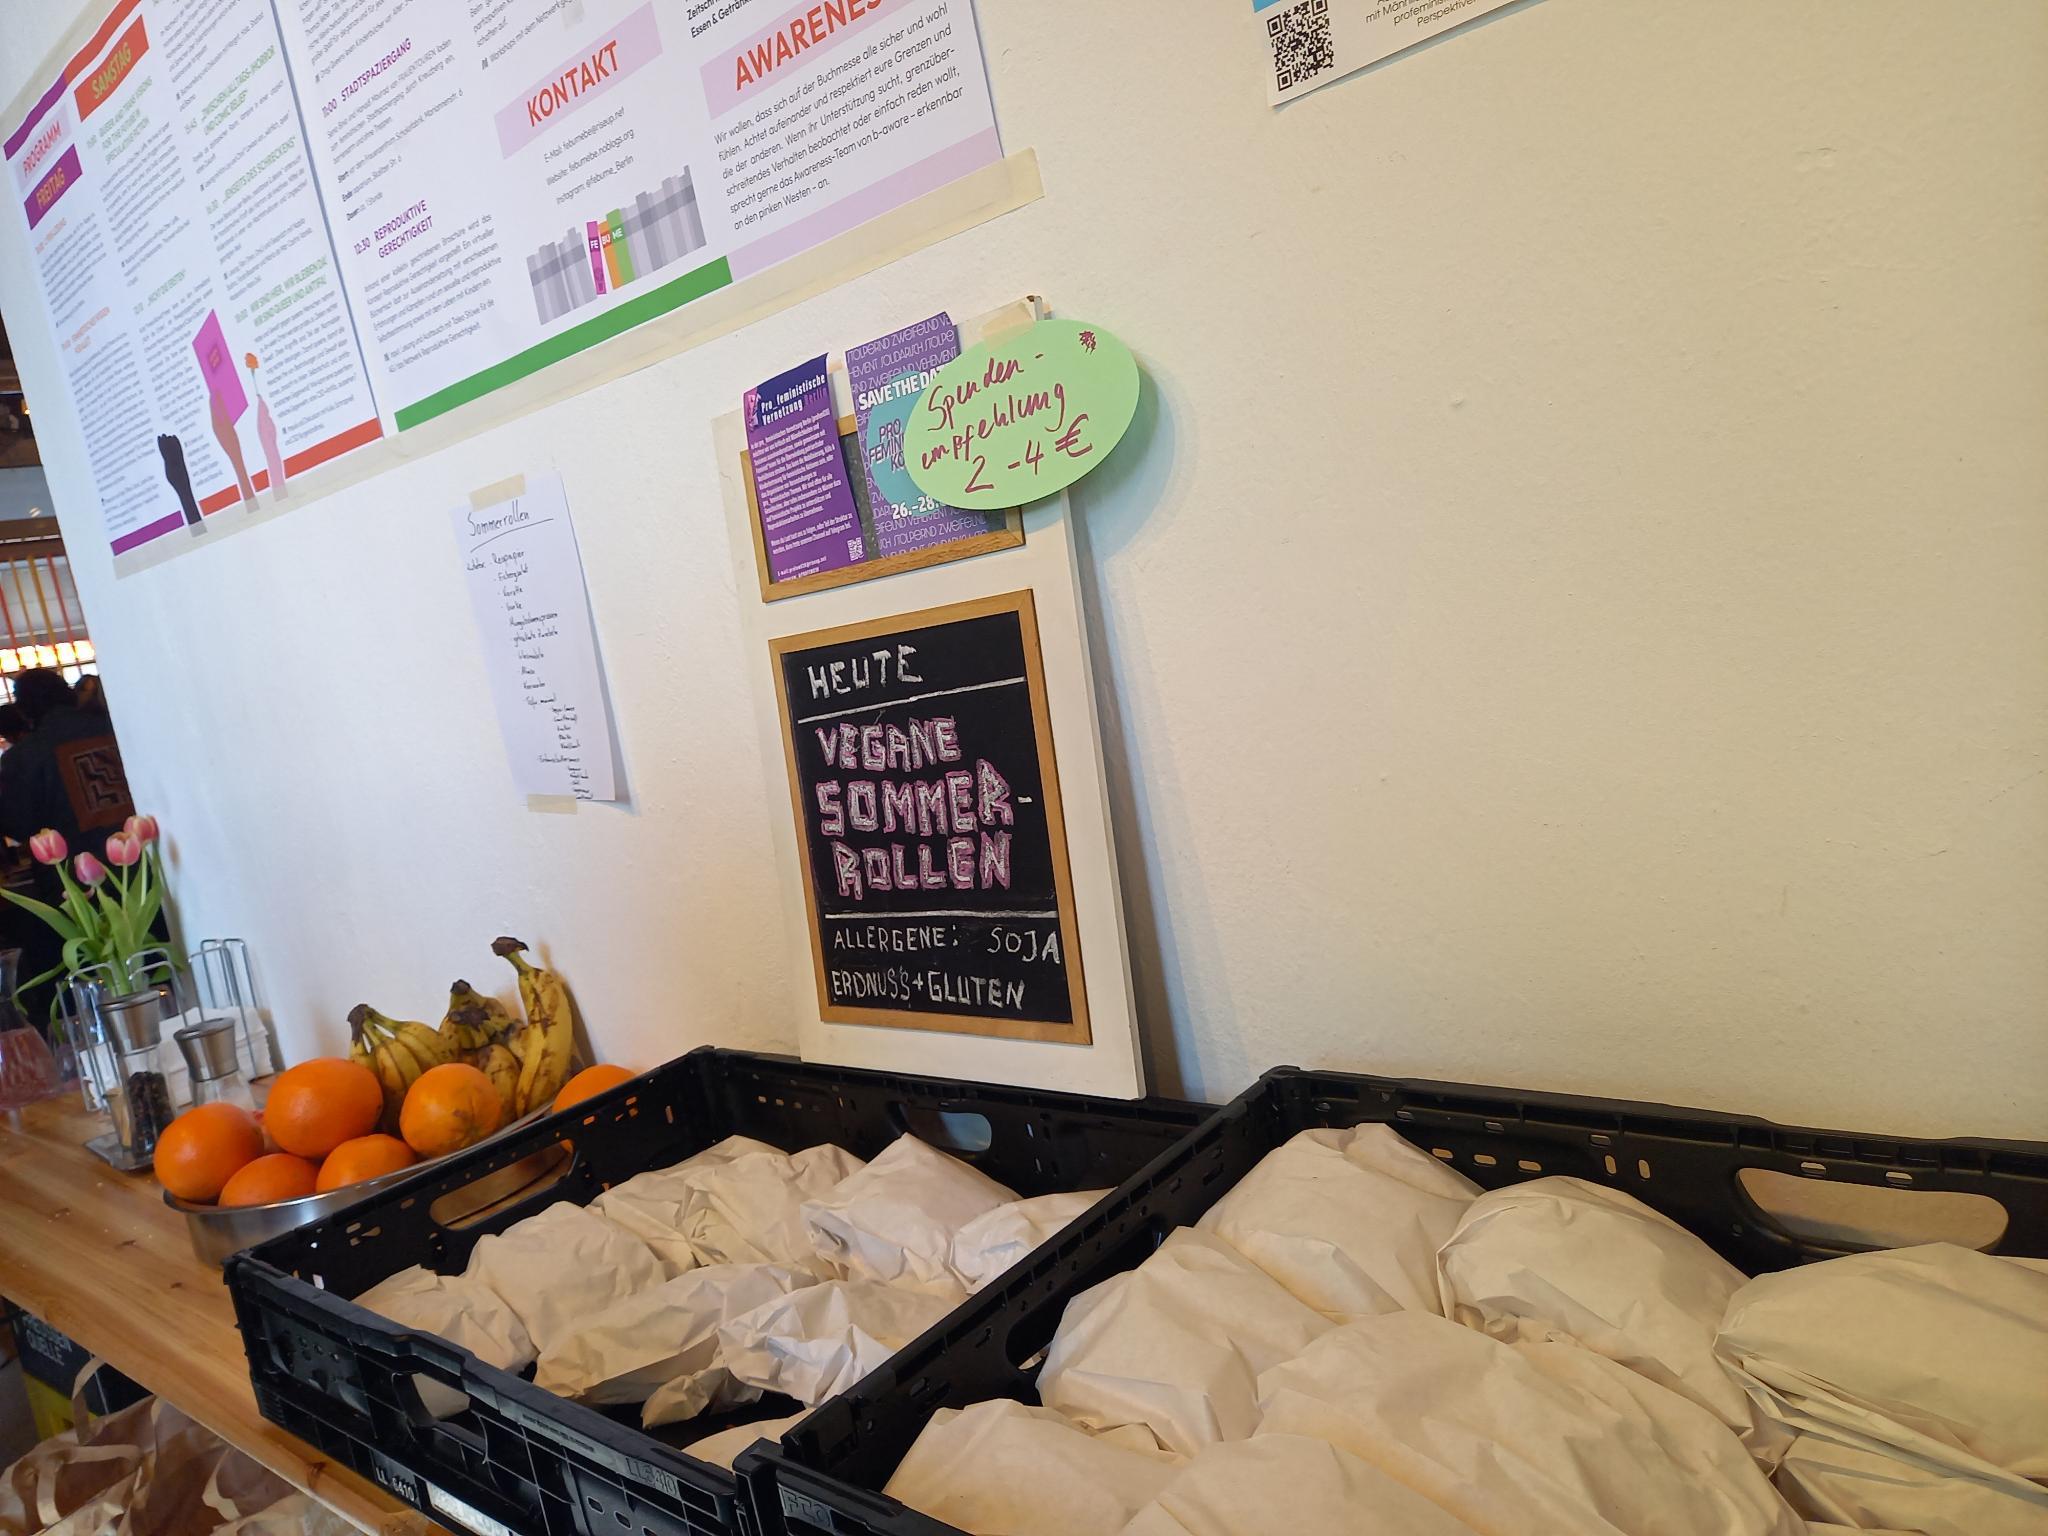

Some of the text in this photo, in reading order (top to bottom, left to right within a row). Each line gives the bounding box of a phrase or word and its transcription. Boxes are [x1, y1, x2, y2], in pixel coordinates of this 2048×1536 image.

[690, 19, 712, 38] Essen
[711, 13, 718, 24] &
[736, 0, 881, 91] AWARENE
[92, 42, 132, 100] SAMSTAG
[341, 37, 412, 101] STADTSPAZIERGANG
[527, 40, 618, 127] KONTAKT
[714, 132, 728, 145] Wir
[755, 107, 773, 123] dass
[774, 97, 789, 113] sich
[789, 88, 802, 104] auf
[803, 80, 815, 95] der
[817, 56, 861, 87] Buchmesse
[863, 45, 878, 61] alle
[879, 29, 905, 54] sicher
[907, 17, 924, 35] und
[926, 2, 948, 24] wohl
[744, 129, 768, 149] Achtet
[769, 106, 811, 135] aufeinander
[814, 94, 829, 110] und
[829, 66, 874, 100] respektiert
[874, 60, 894, 76] eure
[894, 37, 932, 63] Grenzen
[934, 23, 952, 42] und
[722, 48, 956, 180] die der anderen. Wenn ihr Unterstützung sucht, grenzüber-
[726, 65, 960, 197] schreitendes Verhalten beobachtet oder einfach reden wollt,
[22, 119, 63, 178] PROGRAMM
[730, 193, 756, 214] sprecht
[757, 181, 779, 203] gerne
[779, 173, 793, 188] das
[793, 141, 857, 181] Awareness-Team
[857, 132, 872, 149] von
[872, 114, 910, 140] b-aware
[916, 86, 964, 117] erkennbar
[36, 167, 65, 210] FREITAG
[734, 218, 743, 231] an
[744, 210, 758, 225] den
[758, 200, 783, 222] pinken
[783, 188, 811, 206] Westen
[818, 177, 830, 190] an.
[353, 200, 428, 255] 12:30 REPRODUKTIVE
[378, 216, 434, 258] GERECHTIGKEIT
[590, 239, 599, 250] FE
[612, 228, 623, 240] ME
[761, 373, 825, 413] Pro_feministische
[762, 399, 803, 426] Vernetzung
[858, 386, 893, 411] SAVE
[892, 375, 920, 398] THE
[922, 383, 1066, 470] empfehlung
[964, 455, 995, 493] 2
[1055, 413, 1093, 457] €
[467, 499, 530, 537] Sommerrollen
[807, 644, 924, 699] HEUTE
[815, 715, 962, 773] VEGANE
[815, 758, 1032, 838] SOMMER-
[830, 830, 1013, 900] ROLLEN
[834, 924, 1062, 965] ALLERGENE: SOJA
